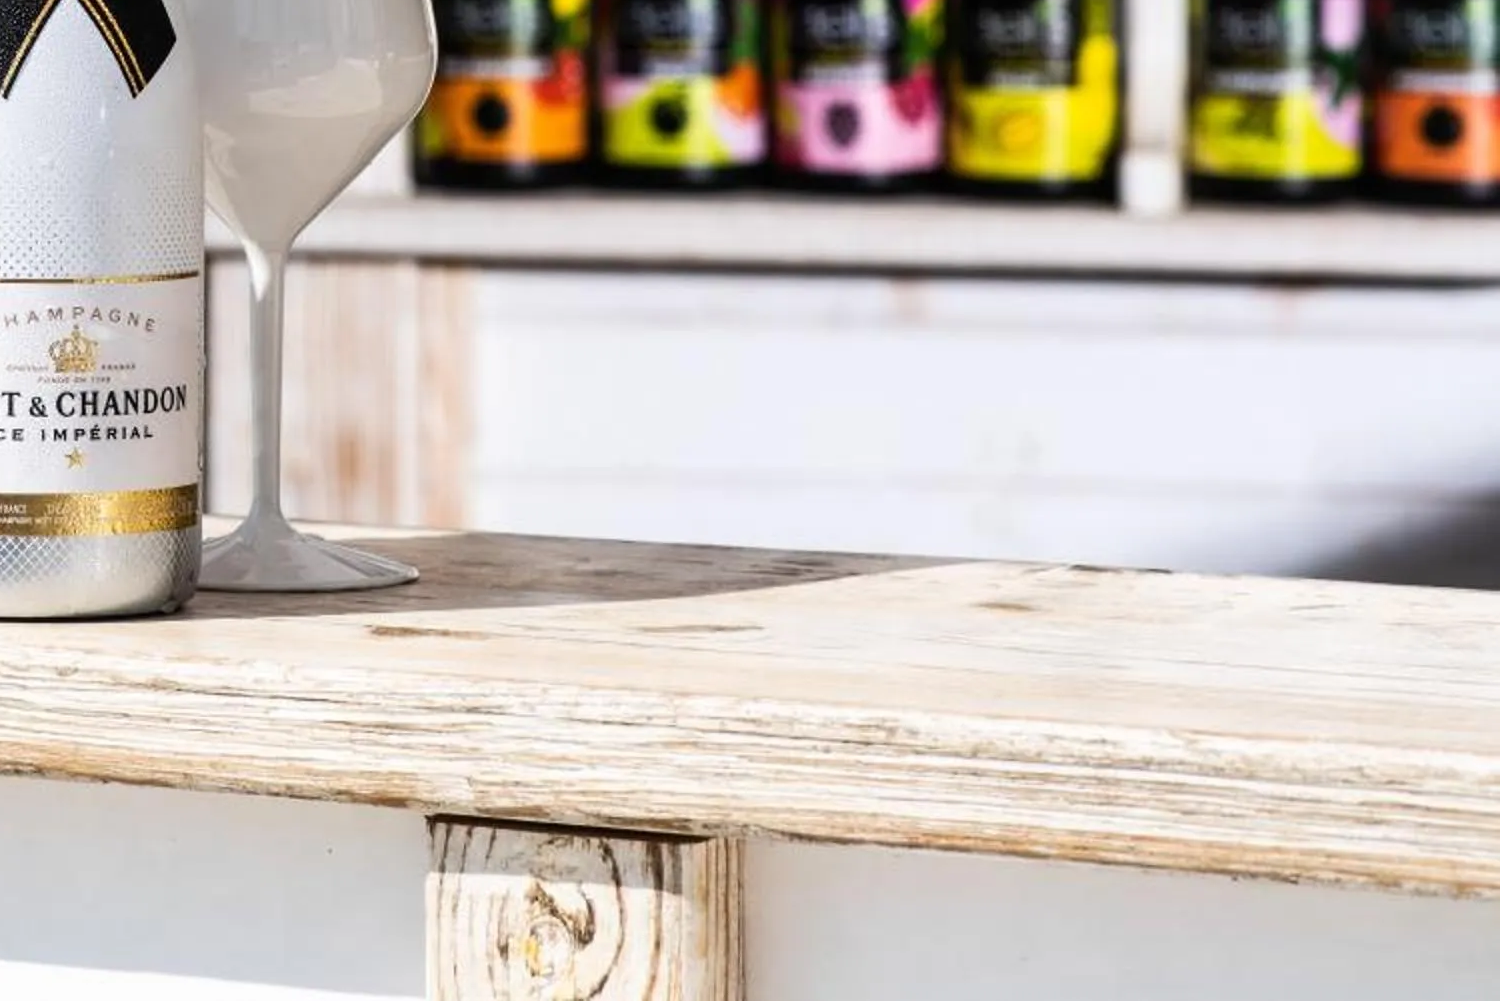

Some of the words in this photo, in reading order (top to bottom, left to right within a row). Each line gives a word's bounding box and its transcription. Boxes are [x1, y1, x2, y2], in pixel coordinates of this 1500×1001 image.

[29, 396, 48, 417] &
[55, 384, 188, 417] CHANDON
[41, 425, 155, 442] IMPÉRIAL
